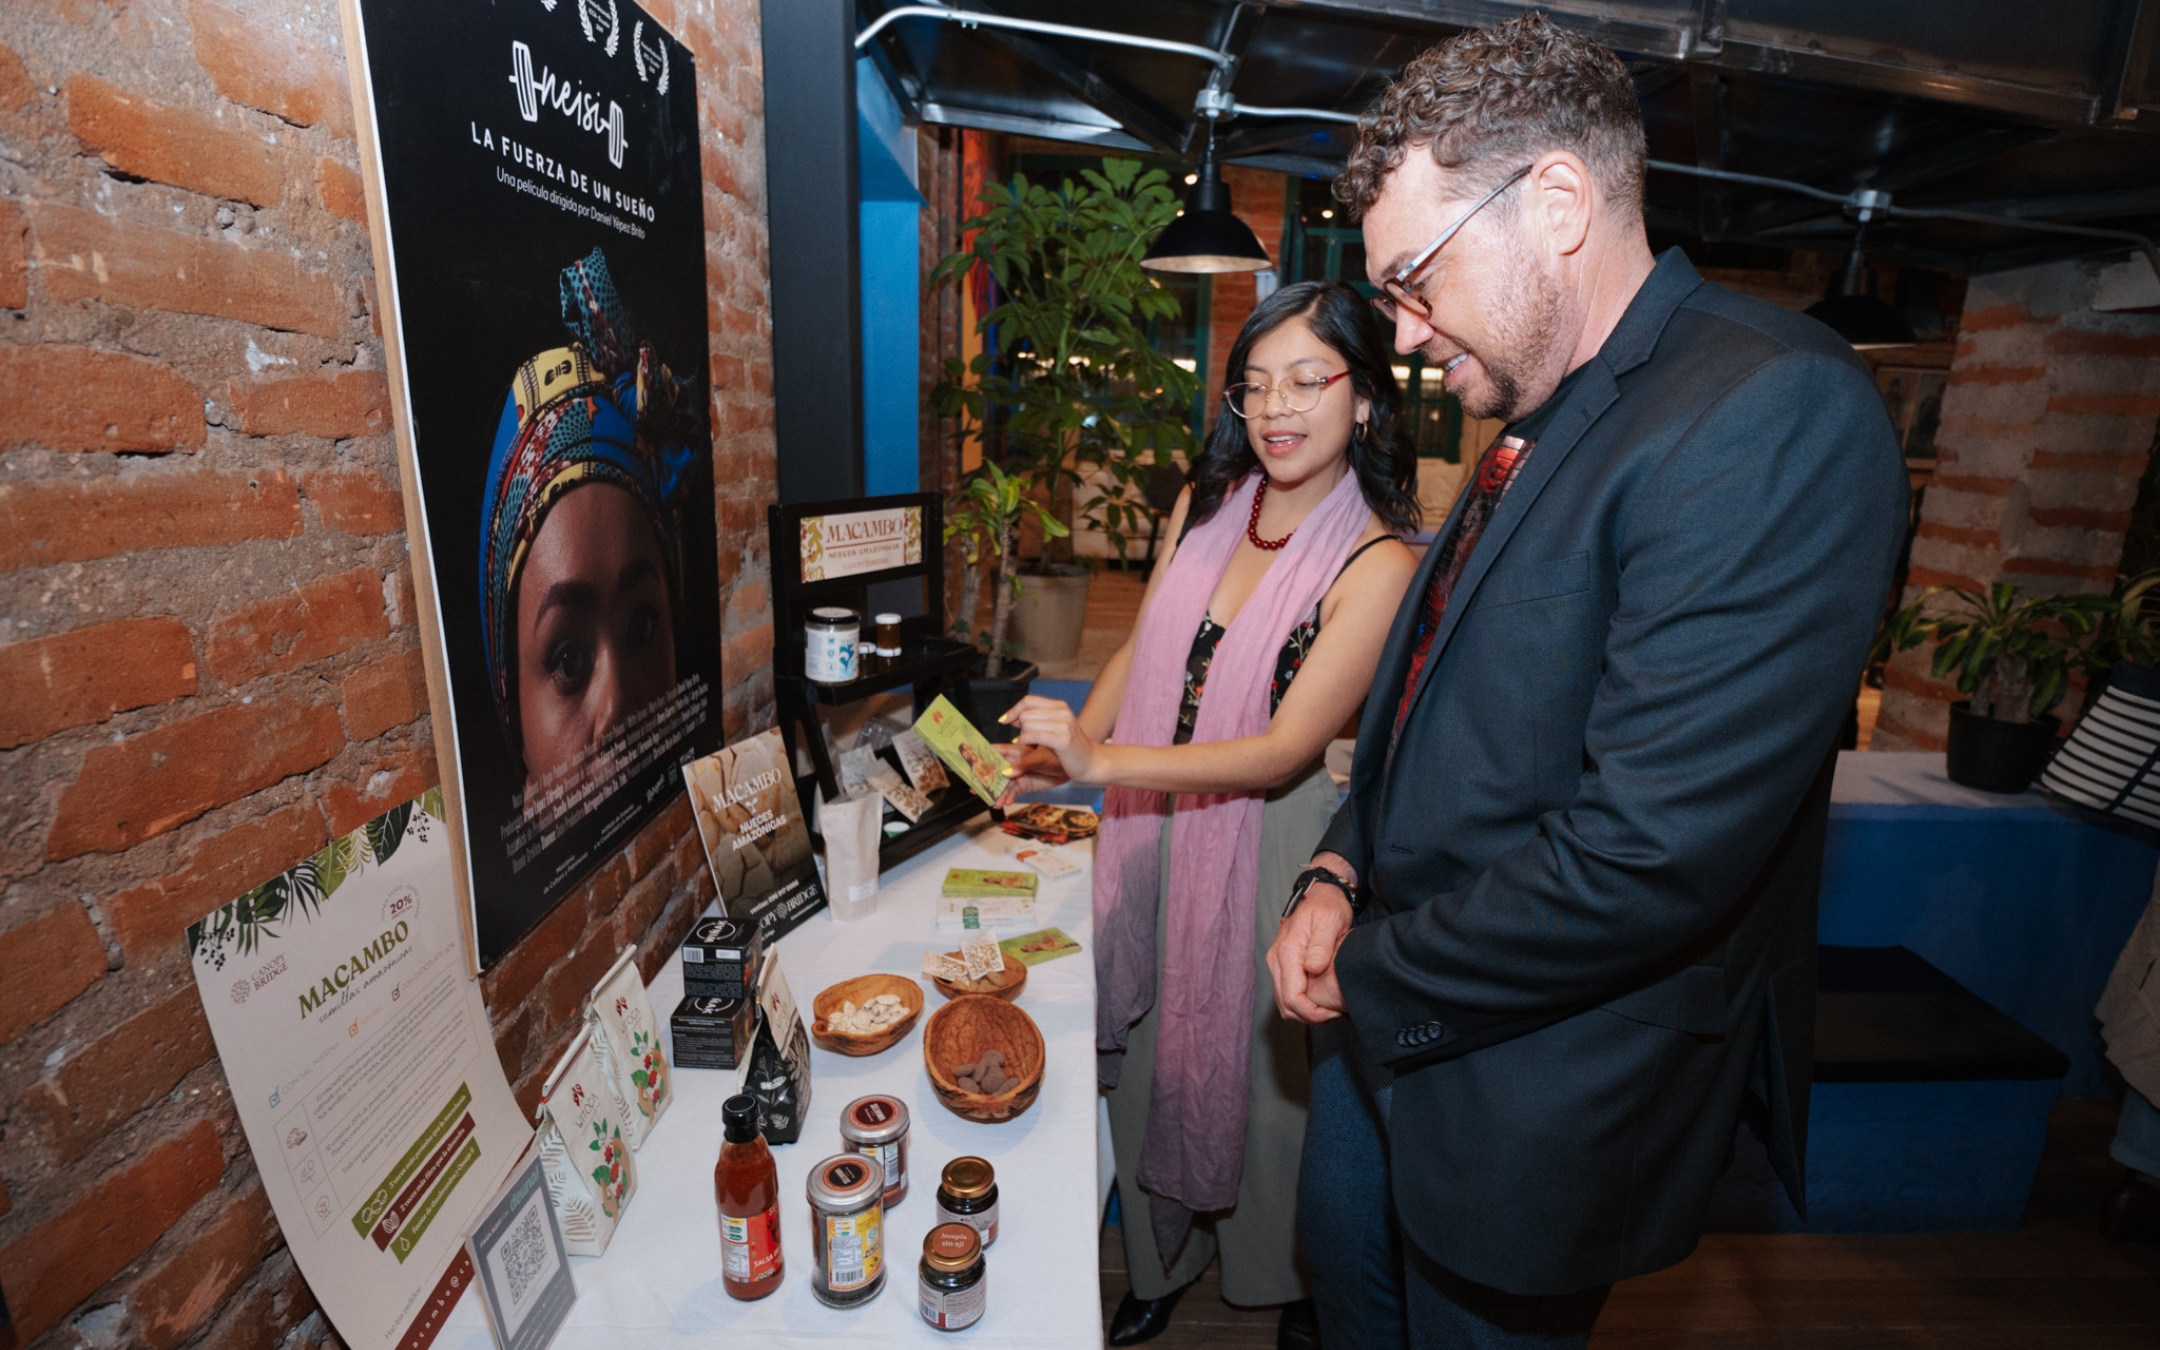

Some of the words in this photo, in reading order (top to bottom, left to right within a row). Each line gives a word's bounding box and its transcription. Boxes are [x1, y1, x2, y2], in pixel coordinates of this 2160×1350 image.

[471, 121, 494, 151] LA
[501, 136, 565, 183] FUERZA
[570, 169, 589, 193] DE
[593, 180, 611, 203] UN
[615, 190, 655, 222] SUEÑO
[496, 166, 515, 187] Una
[516, 178, 549, 200] película
[550, 190, 577, 212] dirigida
[578, 204, 590, 218] por
[590, 206, 611, 226] Daniel
[631, 224, 646, 239] Brito
[826, 517, 902, 543] MACAMBO
[712, 767, 782, 813] MACAMBO
[732, 814, 787, 852] AMAZÓNICAS
[739, 809, 774, 834] NUECES
[389, 892, 412, 915] 20%
[787, 884, 819, 916] BRIDGE
[250, 952, 286, 979] CANOPY
[254, 961, 289, 991] BRIDGE
[298, 920, 409, 1021] MACAMBO
[318, 982, 361, 1024] semillas
[362, 945, 414, 993] amazónicas
[619, 1007, 641, 1034] WITOCA
[575, 1092, 598, 1128] WITOCA
[754, 1254, 773, 1267] SALSA
